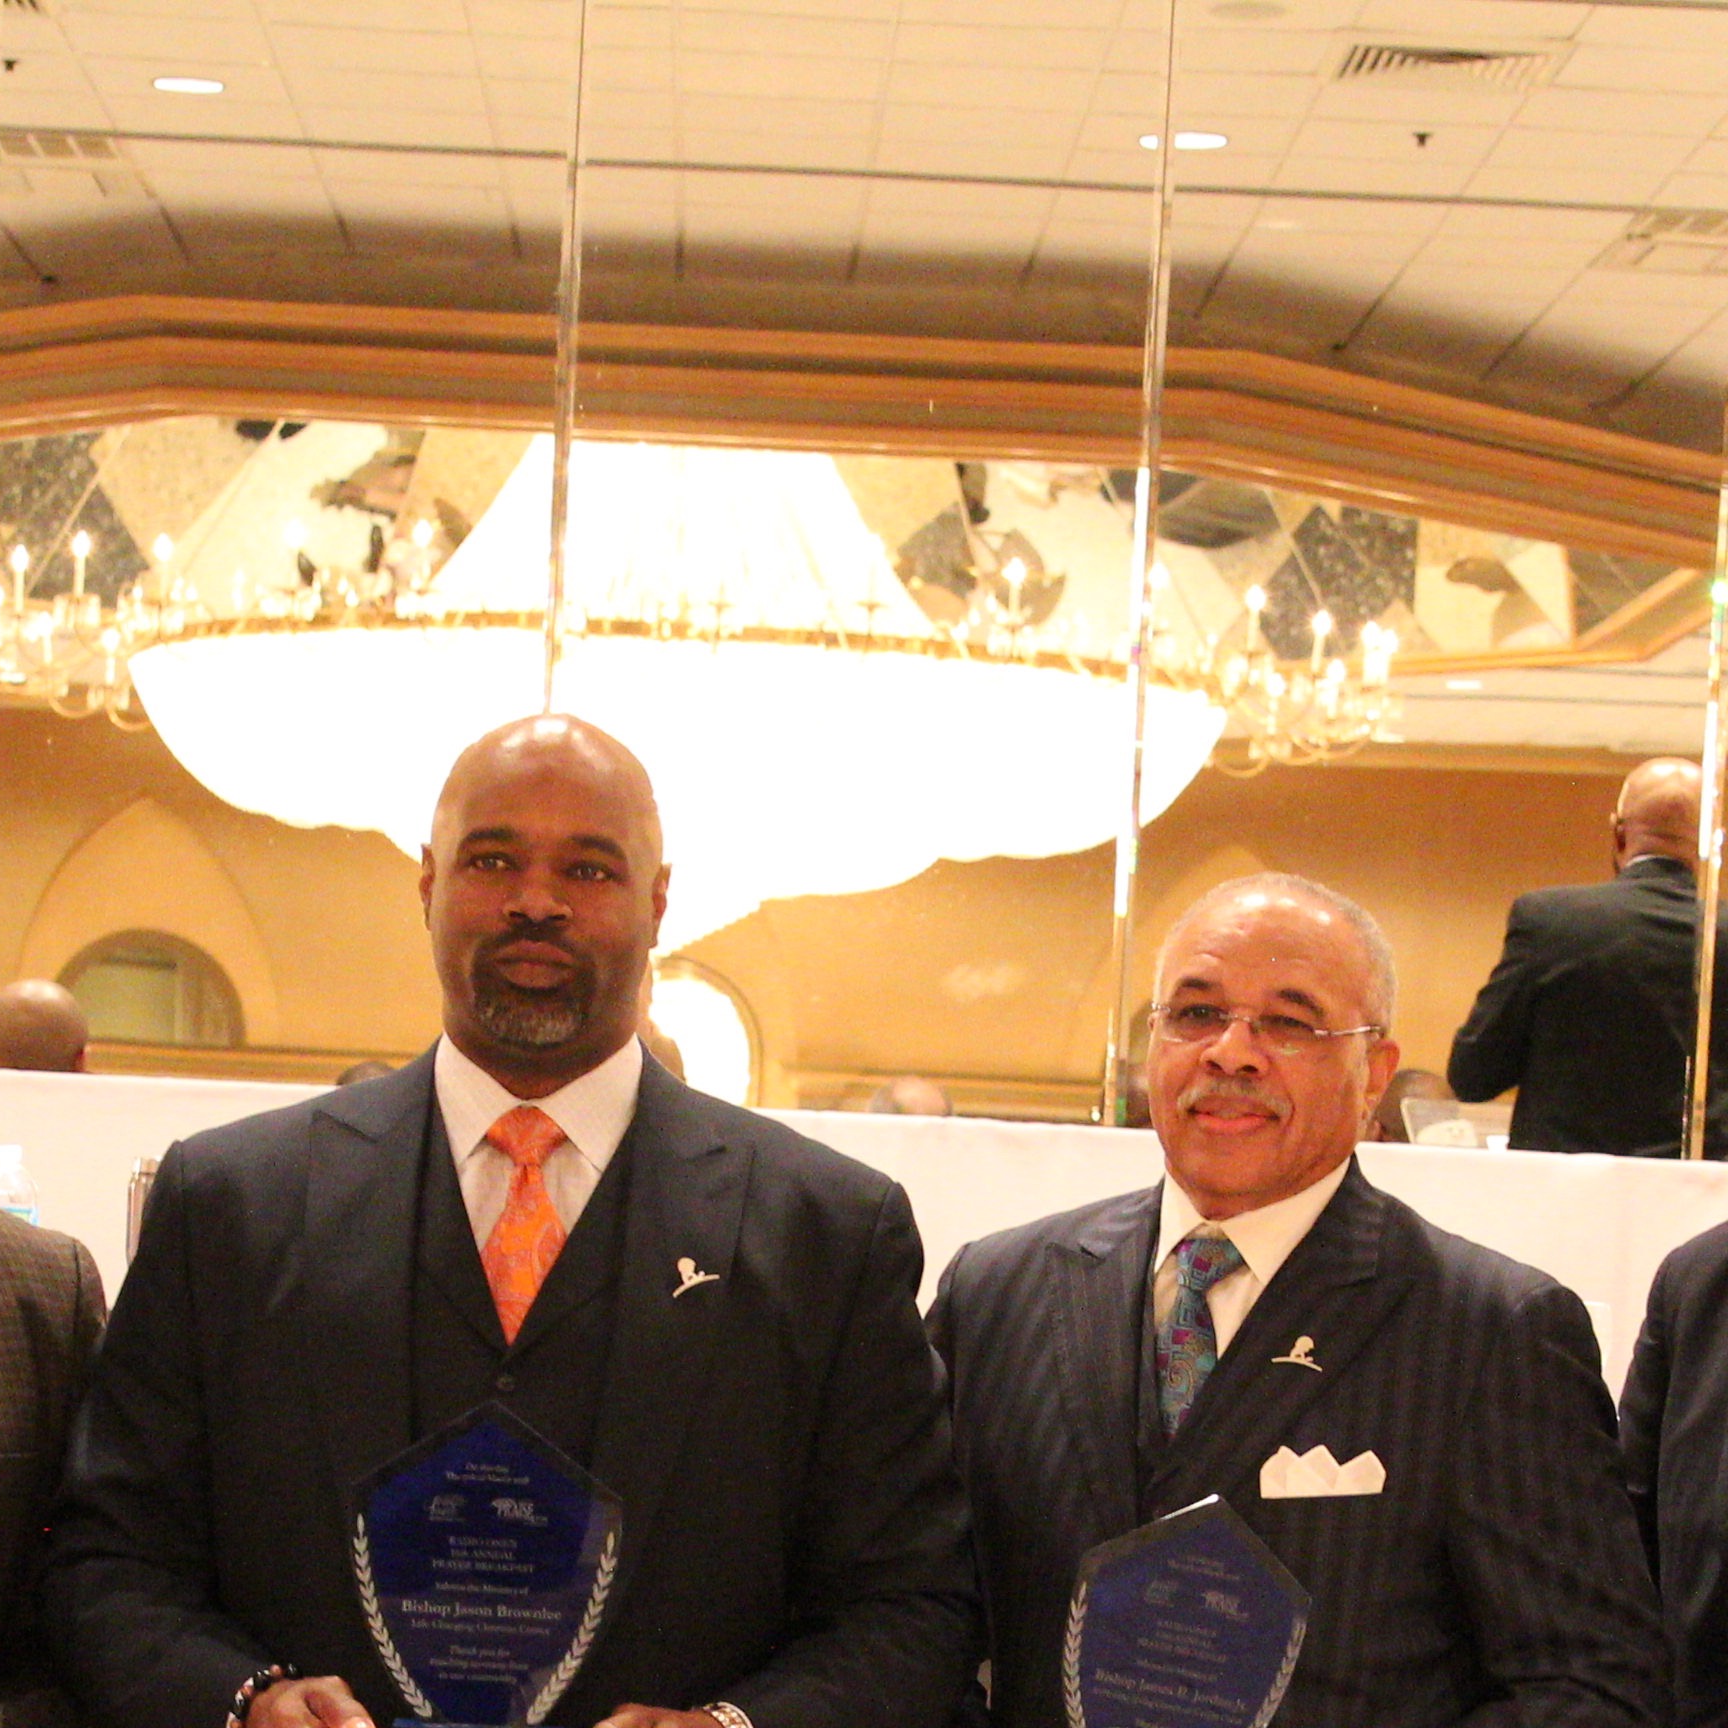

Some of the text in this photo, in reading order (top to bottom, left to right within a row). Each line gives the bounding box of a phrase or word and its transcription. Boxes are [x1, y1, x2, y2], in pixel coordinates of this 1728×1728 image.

[401, 1598, 562, 1621] Bishop Jason Brownlee
